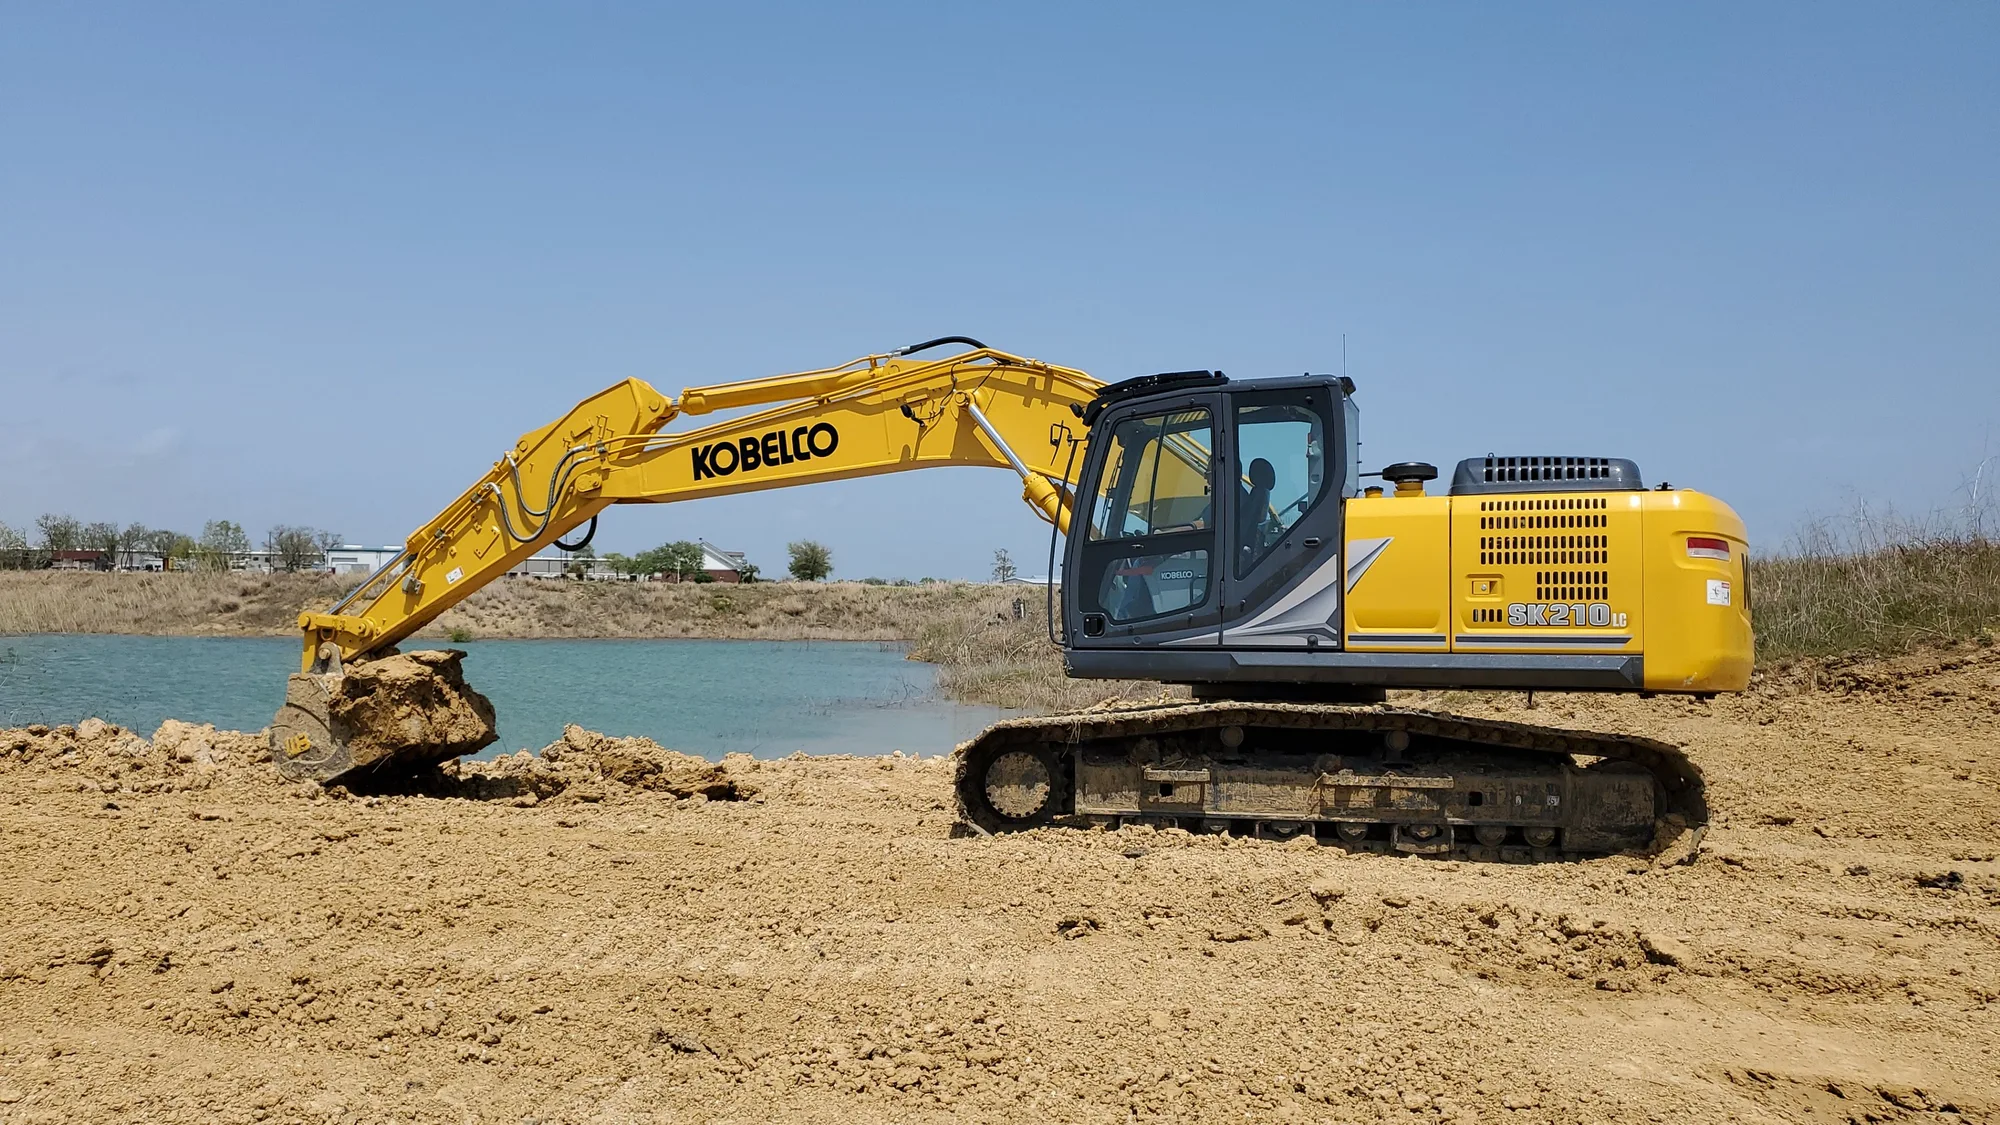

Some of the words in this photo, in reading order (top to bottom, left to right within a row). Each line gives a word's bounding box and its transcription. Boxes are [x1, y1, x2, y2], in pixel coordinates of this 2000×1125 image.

[691, 422, 839, 481] KOBELCO
[1160, 570, 1193, 580] KOBELCO
[1508, 603, 1611, 626] SK210
[1612, 612, 1627, 627] LC
